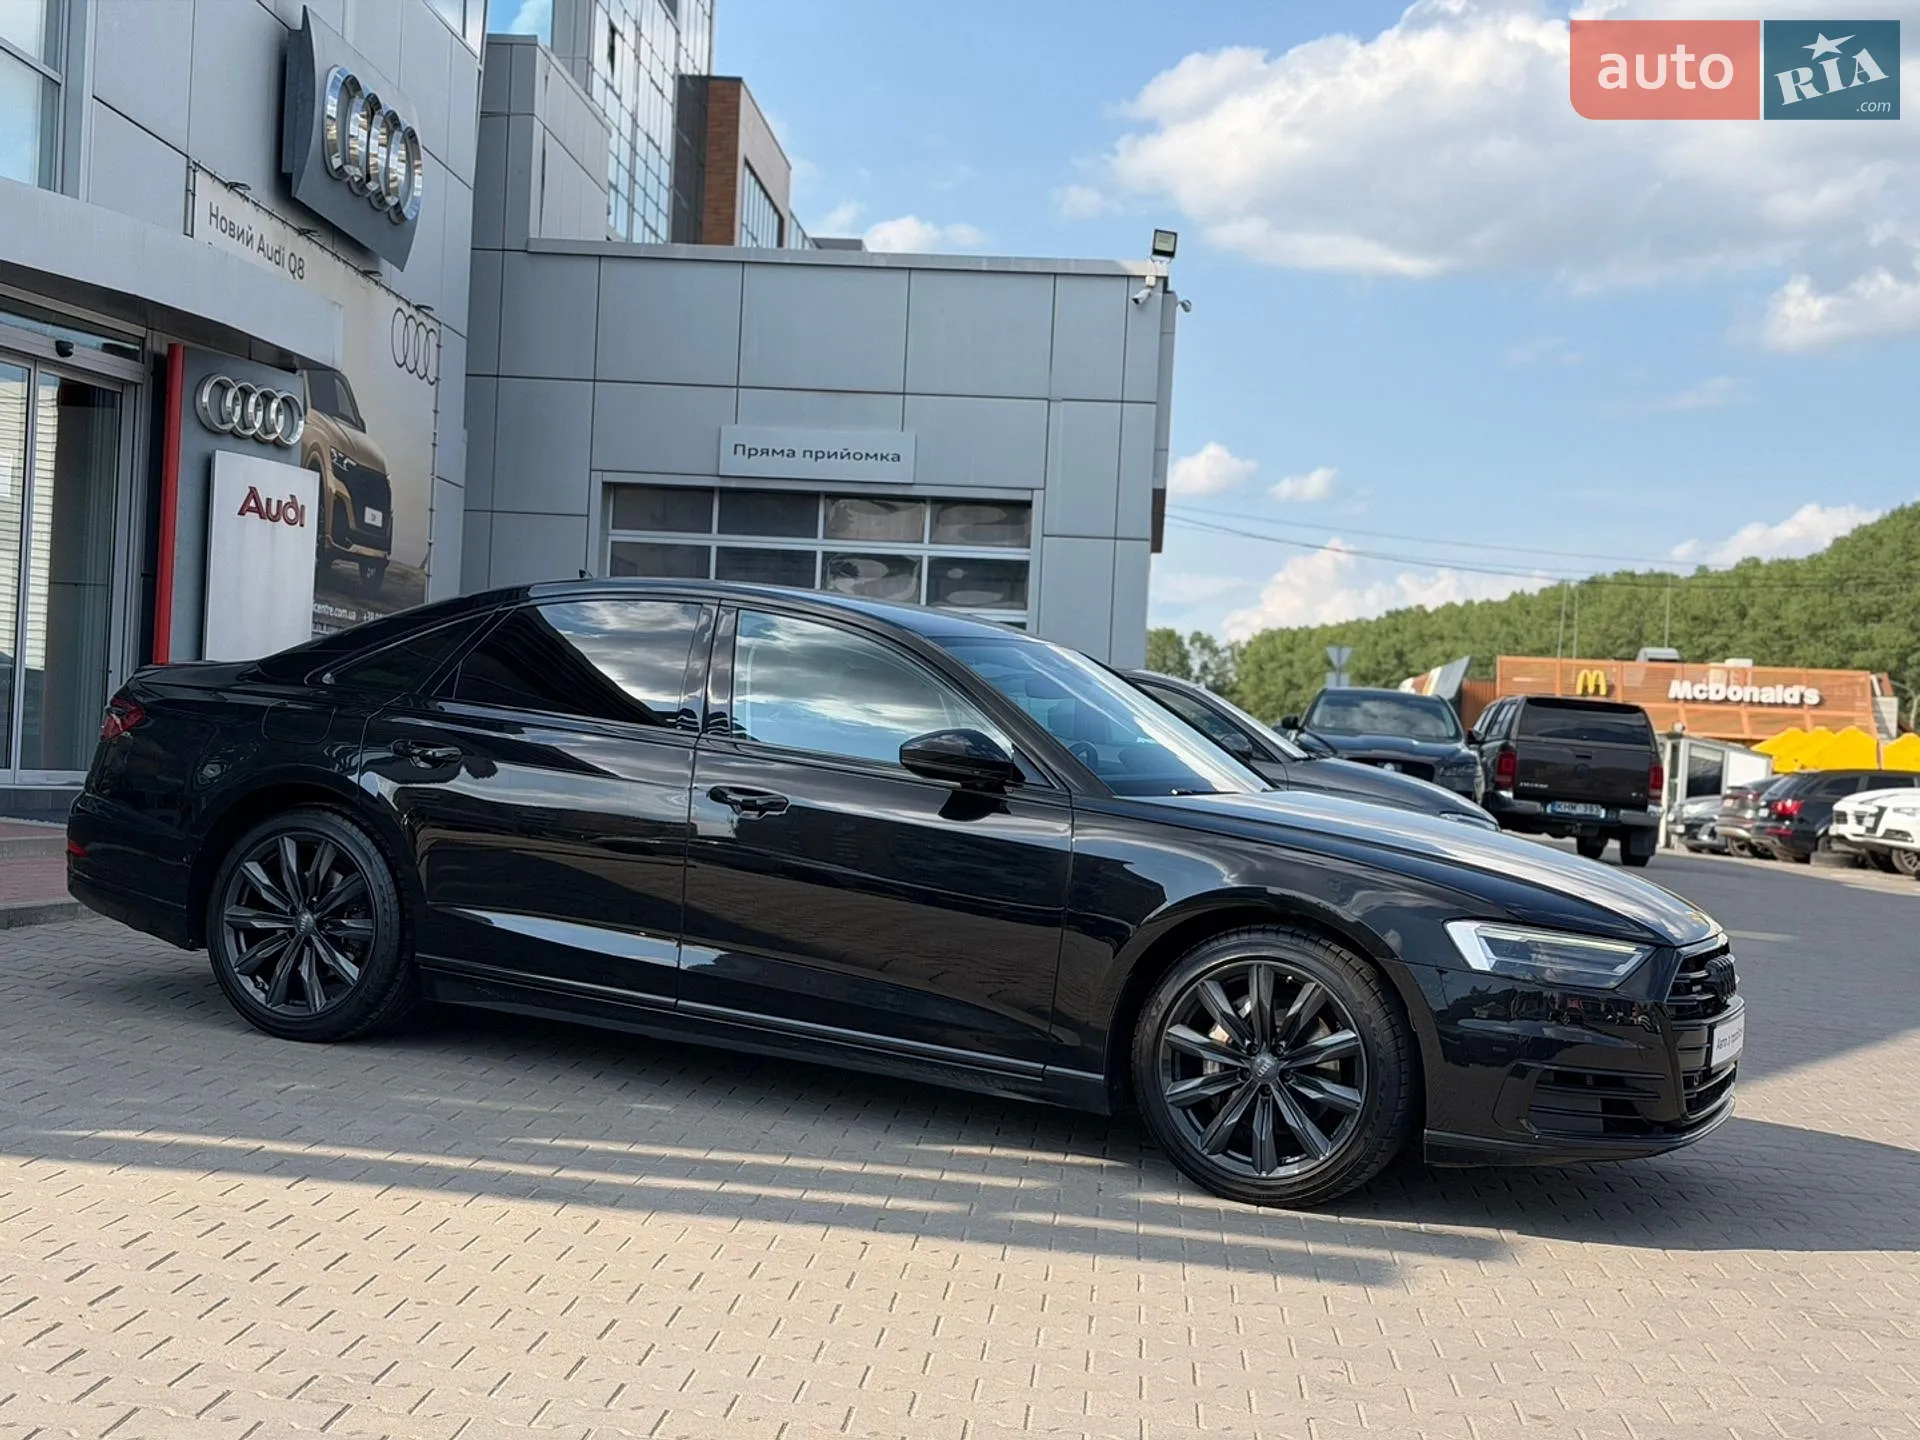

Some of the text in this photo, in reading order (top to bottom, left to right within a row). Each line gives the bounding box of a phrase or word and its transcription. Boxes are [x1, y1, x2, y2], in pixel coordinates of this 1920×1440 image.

[208, 201, 306, 281] Новий Audi Q8
[733, 443, 901, 463] Пряма прийомка
[237, 485, 305, 528] Audi
[1668, 679, 1821, 705] McDonald's
